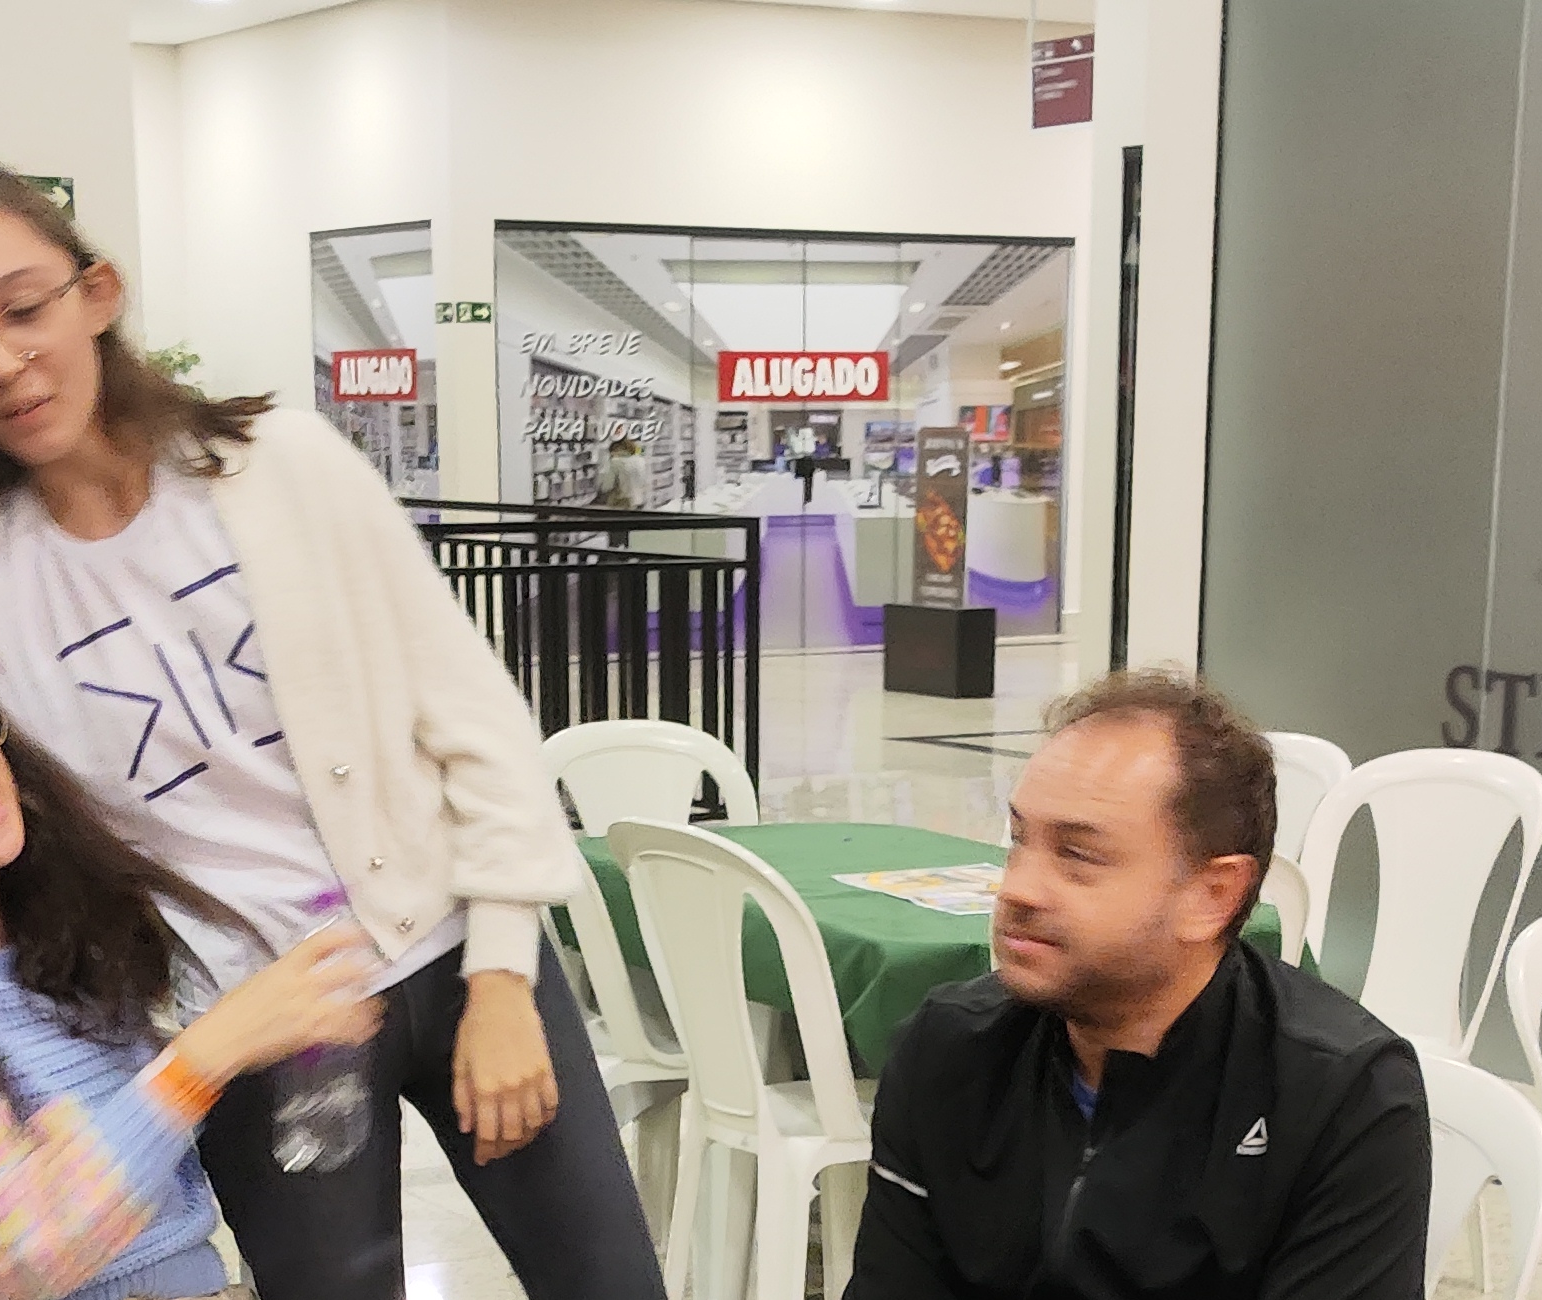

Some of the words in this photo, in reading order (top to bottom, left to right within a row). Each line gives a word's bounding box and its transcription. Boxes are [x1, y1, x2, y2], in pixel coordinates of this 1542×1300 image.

[520, 332, 556, 355] EM
[520, 373, 656, 400] NOVIDADES
[731, 356, 880, 397] ALUGADO
[521, 418, 586, 443] PARA
